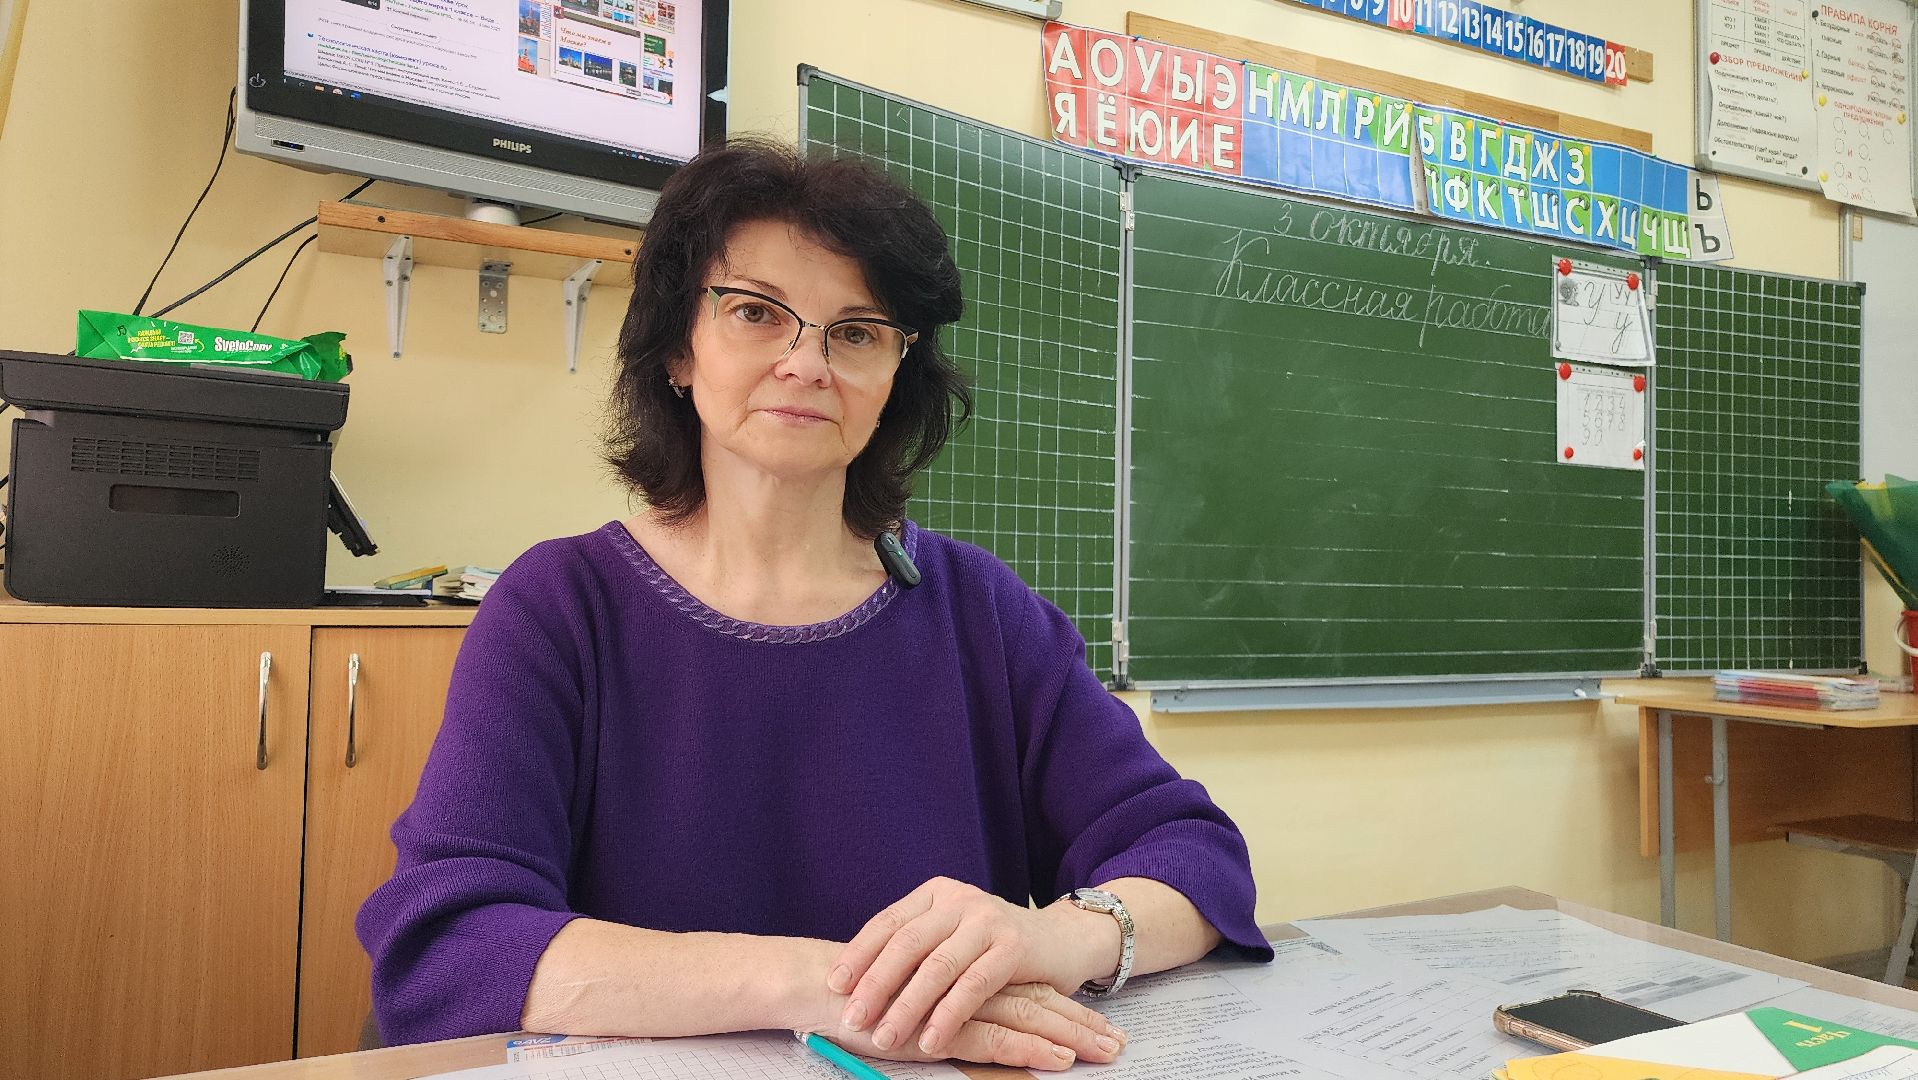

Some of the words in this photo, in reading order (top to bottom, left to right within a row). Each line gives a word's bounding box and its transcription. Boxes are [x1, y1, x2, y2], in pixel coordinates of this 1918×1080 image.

[1393, 0, 1411, 22] 10
[1416, 0, 1431, 27] 11
[1439, 1, 1458, 34] 12
[1462, 7, 1480, 39] 13
[1484, 13, 1502, 46] 14
[1505, 20, 1523, 52] 15
[1527, 26, 1543, 58] 16
[1547, 32, 1564, 63] 17
[1567, 37, 1585, 70] 18
[1587, 43, 1604, 75] 19
[1606, 48, 1627, 80] 20
[1821, 4, 1865, 26] ПРАВИЛА
[1868, 18, 1897, 36] КОРНЯ
[1048, 32, 1082, 80] А
[1090, 38, 1124, 87] О
[1135, 46, 1164, 94] У
[1172, 59, 1203, 106] Ы
[1212, 64, 1237, 111] Э
[1249, 70, 1274, 118] Н
[1280, 80, 1311, 129] М
[1315, 90, 1340, 133] Л
[1353, 97, 1375, 141] Р
[1383, 102, 1410, 150] Й
[492, 138, 532, 154] PHILIPS
[1055, 92, 1076, 138] Я
[1097, 93, 1117, 147] Ё
[1130, 106, 1163, 156] Ю
[1170, 118, 1198, 163] И
[1214, 125, 1234, 169] Е
[1418, 115, 1435, 156] Б
[1450, 121, 1467, 162] В
[1481, 128, 1496, 168] Г
[1504, 135, 1527, 181] Д
[1532, 140, 1559, 182] Ж
[1567, 148, 1584, 186] З
[1696, 178, 1713, 211] Ь
[1274, 203, 1292, 236] 3
[1445, 178, 1470, 212] Ф
[1478, 181, 1499, 220] К
[1508, 187, 1526, 224] Т
[1533, 189, 1559, 231] Ш
[1566, 195, 1585, 235] С
[1598, 200, 1614, 239] Х
[1622, 204, 1638, 250] Ц
[1643, 215, 1658, 250] Ч
[1664, 218, 1690, 258] Щ
[1695, 224, 1721, 253] Ъ
[1215, 228, 1418, 323] Классная
[1419, 284, 1550, 348] работа
[214, 336, 272, 352] SvetoCopy
[1795, 1030, 1852, 1048] Часть
